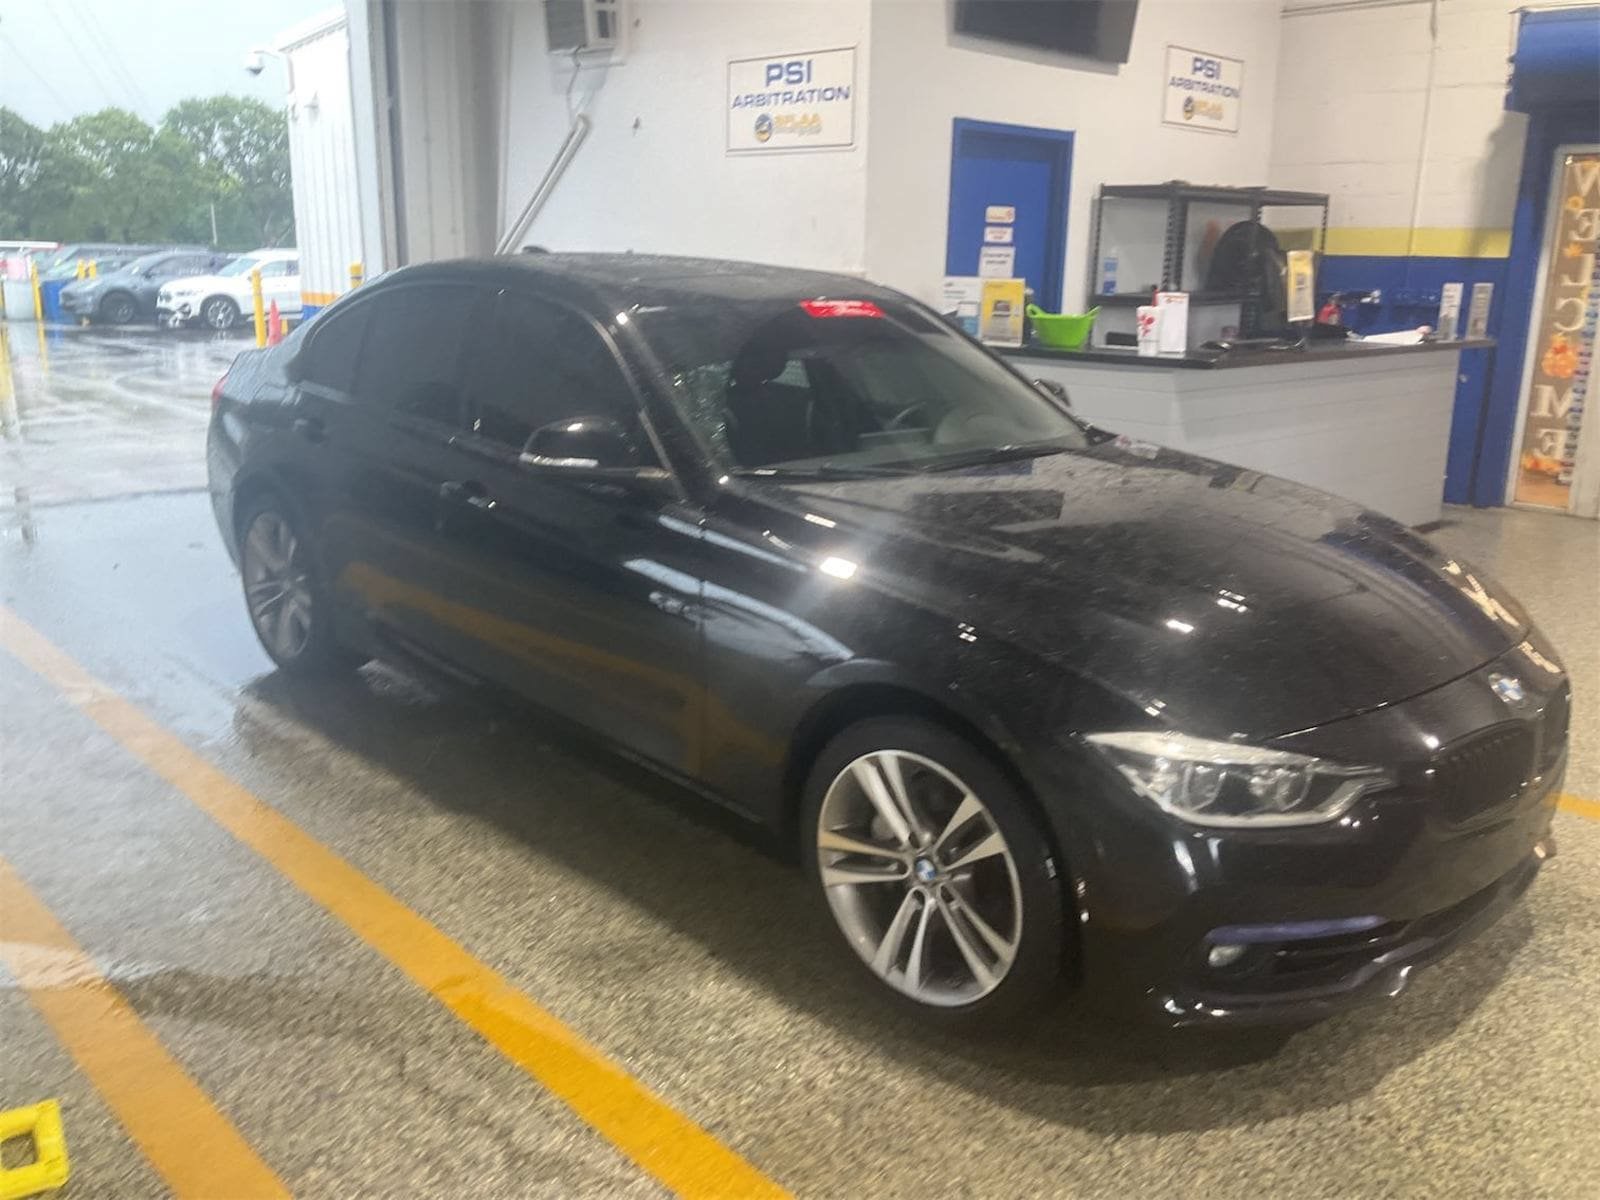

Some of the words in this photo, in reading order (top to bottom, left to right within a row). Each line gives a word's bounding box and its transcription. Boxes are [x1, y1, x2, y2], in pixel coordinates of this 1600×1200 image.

[765, 59, 812, 87] PSI
[1191, 56, 1222, 80] PSI
[731, 86, 850, 110] ARBITRATION
[1168, 76, 1240, 98] ARBITRATION
